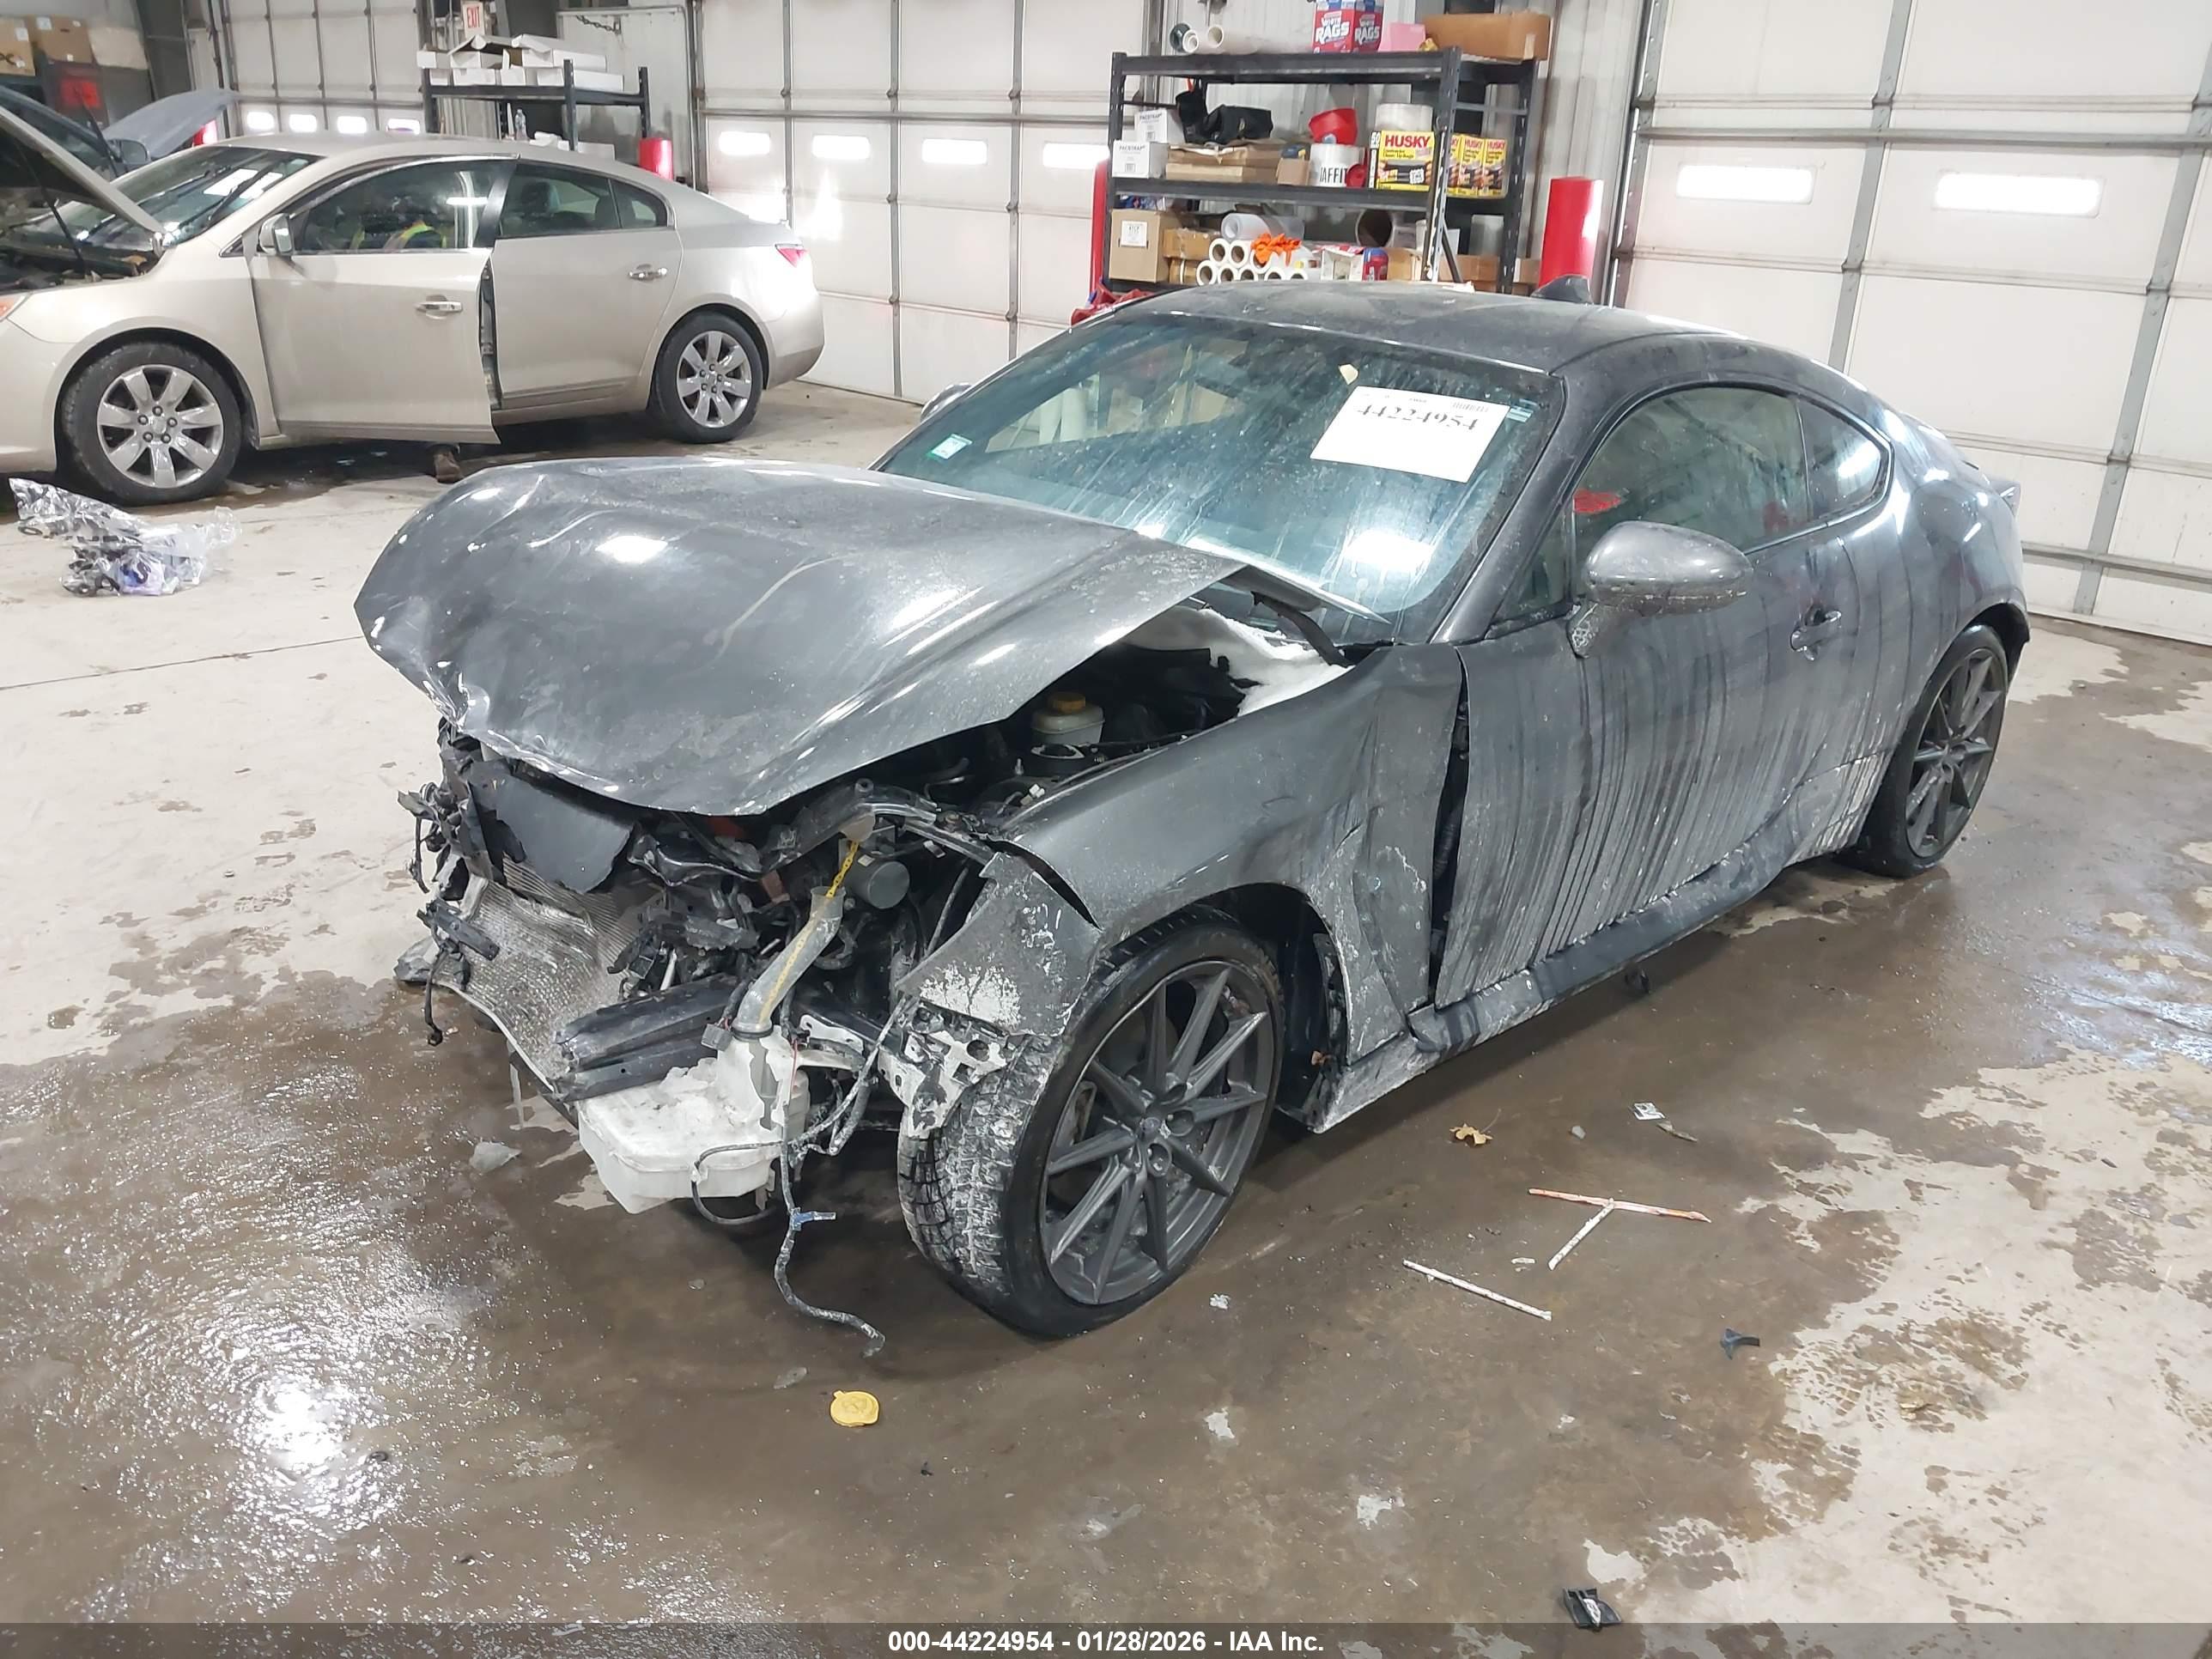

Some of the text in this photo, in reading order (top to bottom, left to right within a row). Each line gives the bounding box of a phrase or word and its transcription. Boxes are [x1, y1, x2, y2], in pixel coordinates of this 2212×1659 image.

[466, 7, 480, 27] EXIT
[1316, 21, 1350, 45] RAGS
[1355, 26, 1380, 45] RAGS
[1385, 135, 1431, 149] HUSKY
[1488, 140, 1505, 149] HUSKY
[1358, 404, 1478, 430] 44224954
